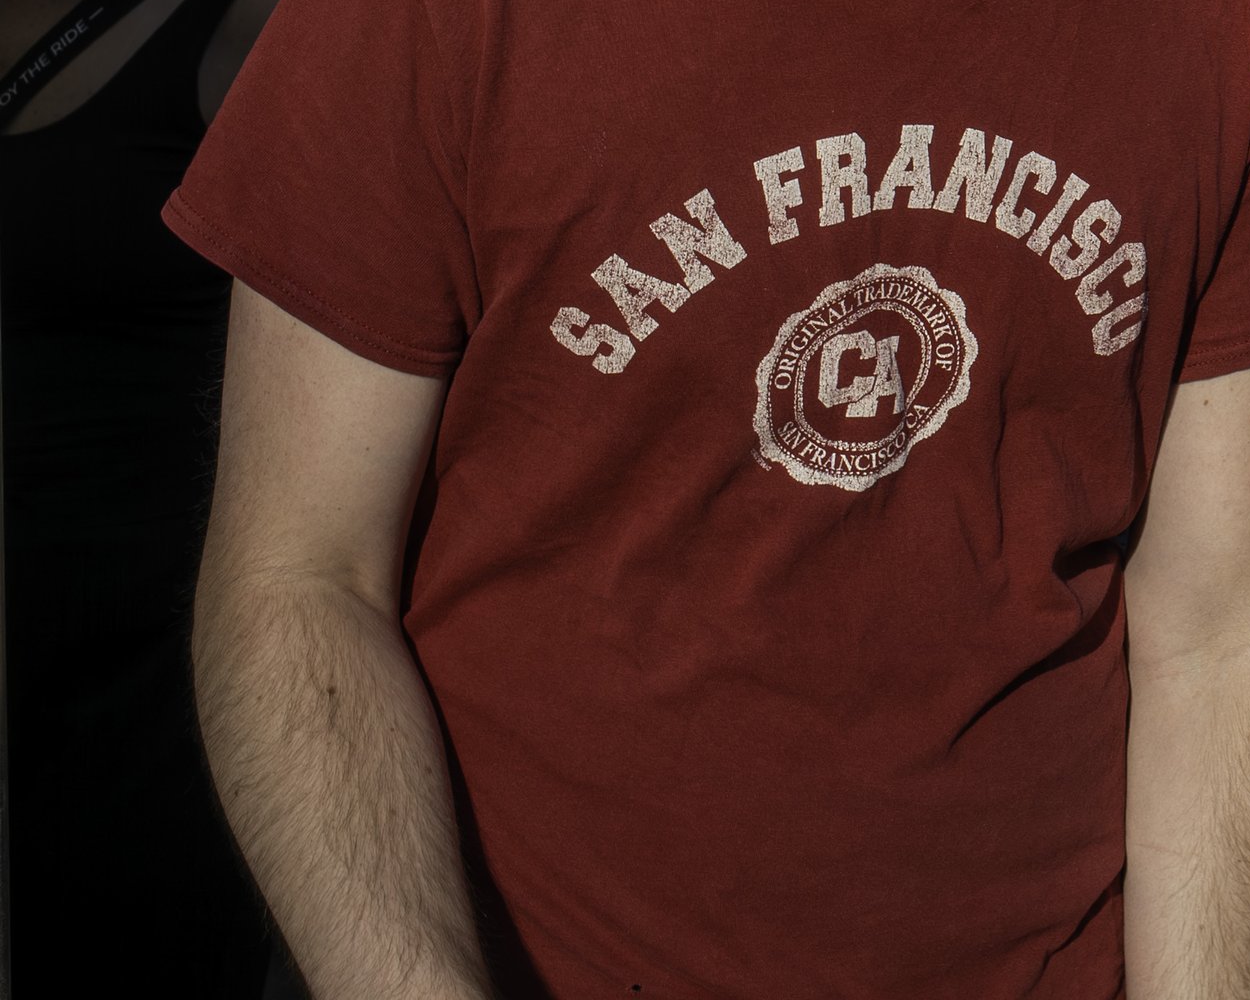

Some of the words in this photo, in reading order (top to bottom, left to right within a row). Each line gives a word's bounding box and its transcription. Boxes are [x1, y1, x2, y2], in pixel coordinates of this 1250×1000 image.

[19, 53, 50, 84] THE
[50, 18, 88, 56] RIDE
[549, 187, 748, 375] SAN
[753, 124, 1150, 357] FRANCISCO
[774, 300, 853, 391] ORIGINAL
[854, 282, 952, 342] TRADEMARK
[935, 343, 955, 372] OF
[817, 329, 906, 419] CA
[777, 420, 802, 450] SAN
[905, 403, 930, 428] CA
